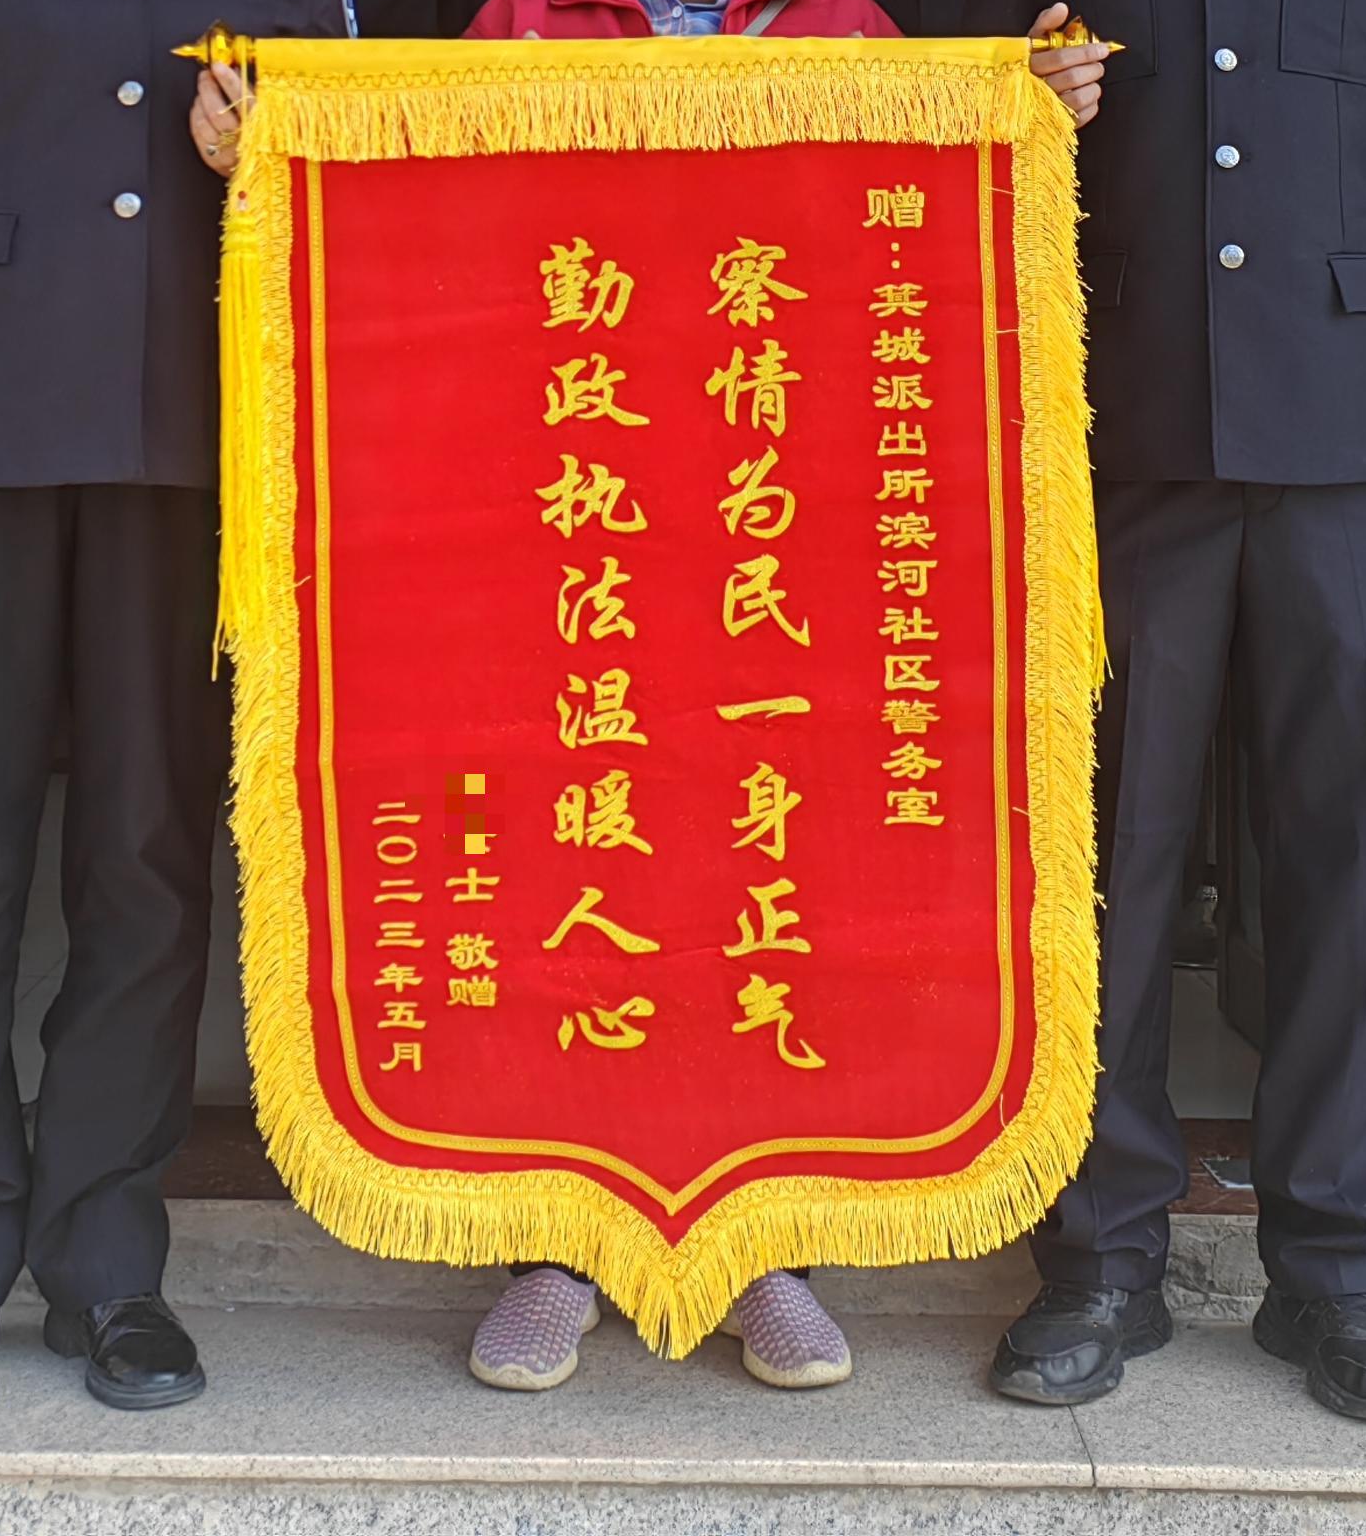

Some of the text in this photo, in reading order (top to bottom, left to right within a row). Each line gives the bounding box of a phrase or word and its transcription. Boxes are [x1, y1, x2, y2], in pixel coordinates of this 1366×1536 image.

[535, 237, 661, 1052] 勤政执法温暖人心
[706, 237, 826, 1070] 察情为民一身正气
